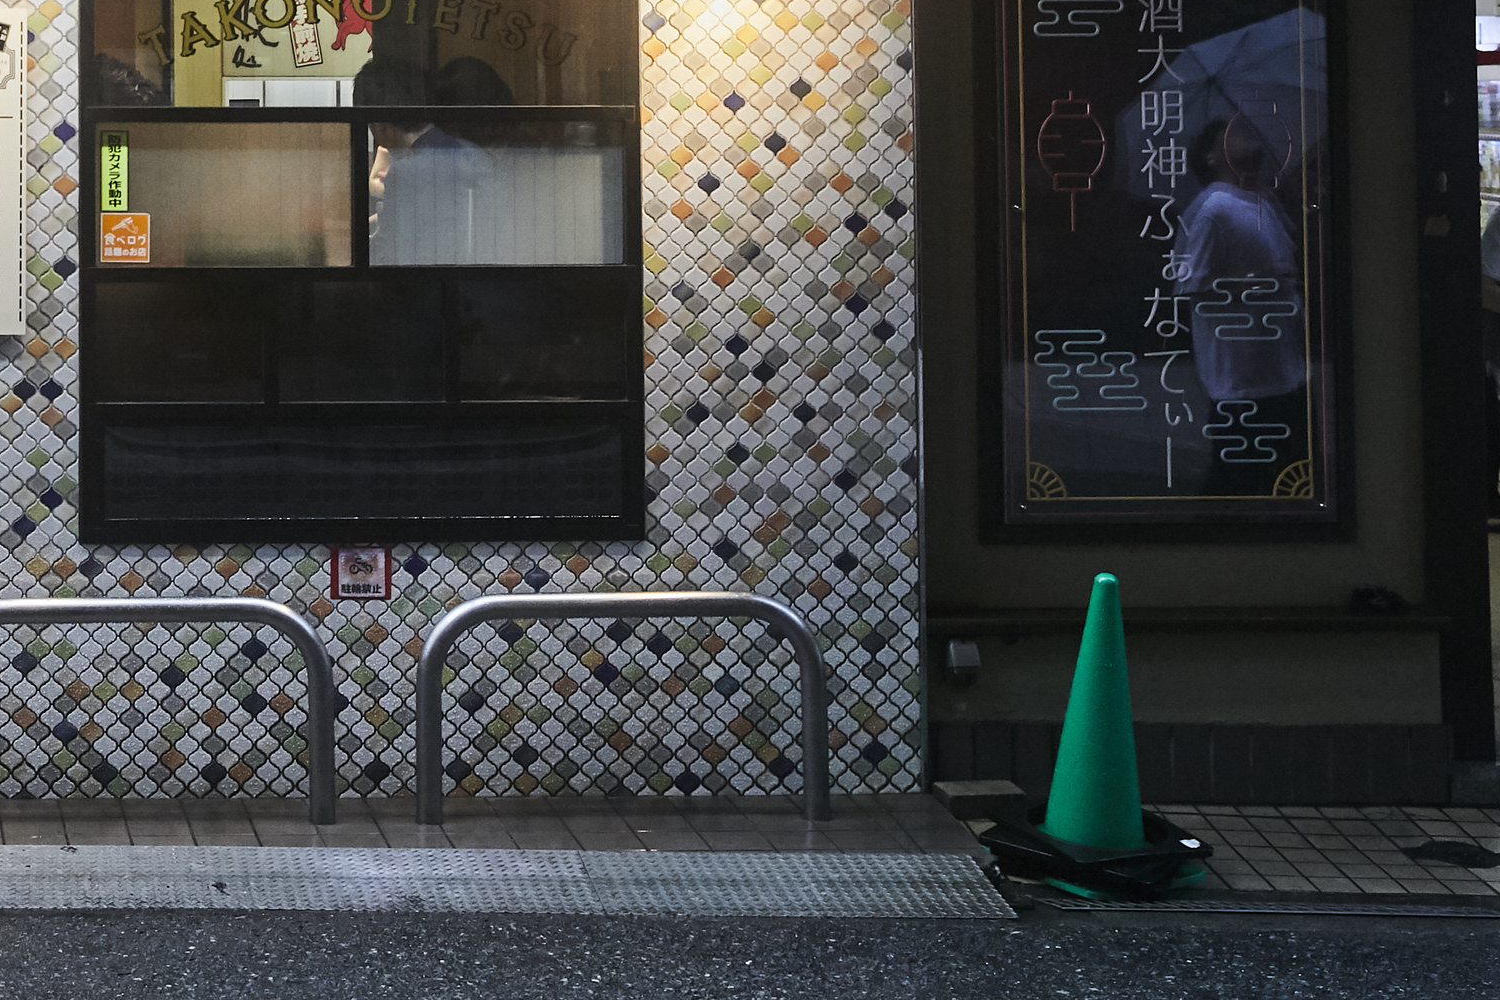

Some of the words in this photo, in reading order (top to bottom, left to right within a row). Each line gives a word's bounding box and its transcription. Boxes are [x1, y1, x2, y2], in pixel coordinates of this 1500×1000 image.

[107, 134, 122, 208] 防犯カメラ作動中
[104, 232, 147, 246] 食べログ
[104, 247, 147, 257] 話題のお店
[340, 583, 382, 594] 駐輪禁止
